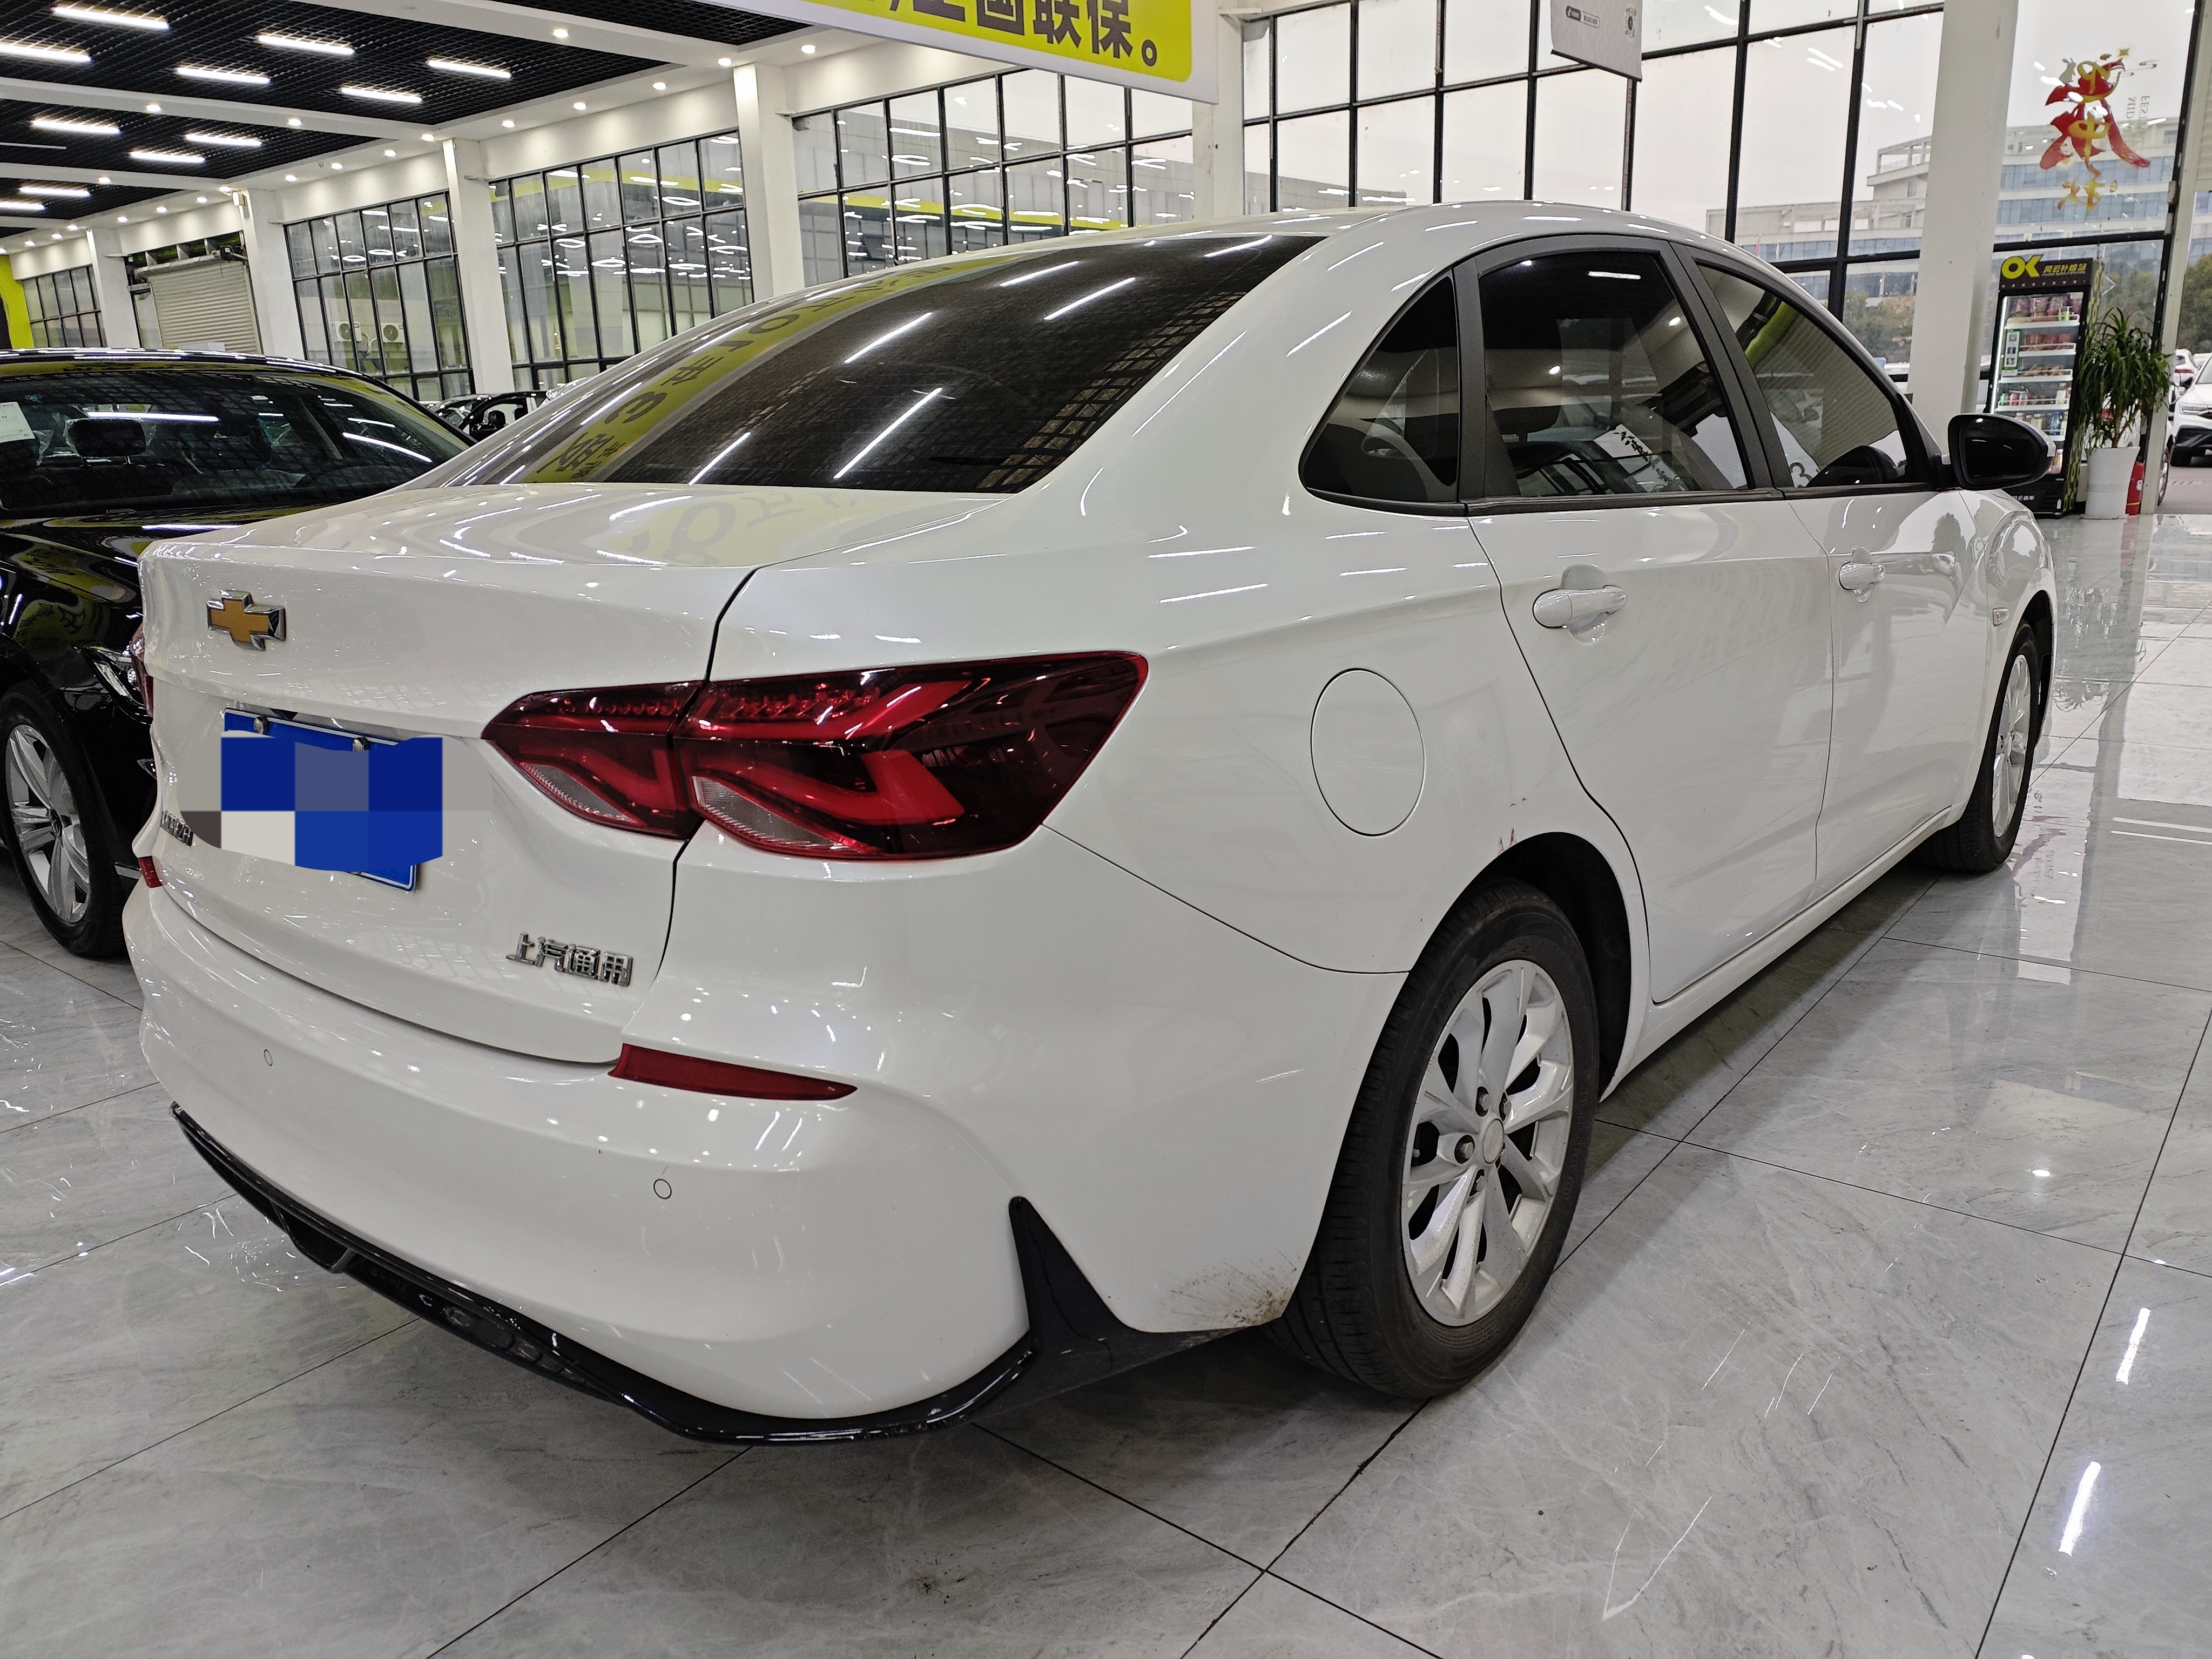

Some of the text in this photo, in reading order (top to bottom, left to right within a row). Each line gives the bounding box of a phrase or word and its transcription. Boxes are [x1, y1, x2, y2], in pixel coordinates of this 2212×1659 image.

[2001, 254, 2044, 279] OK
[505, 932, 633, 987] 上汽通用
